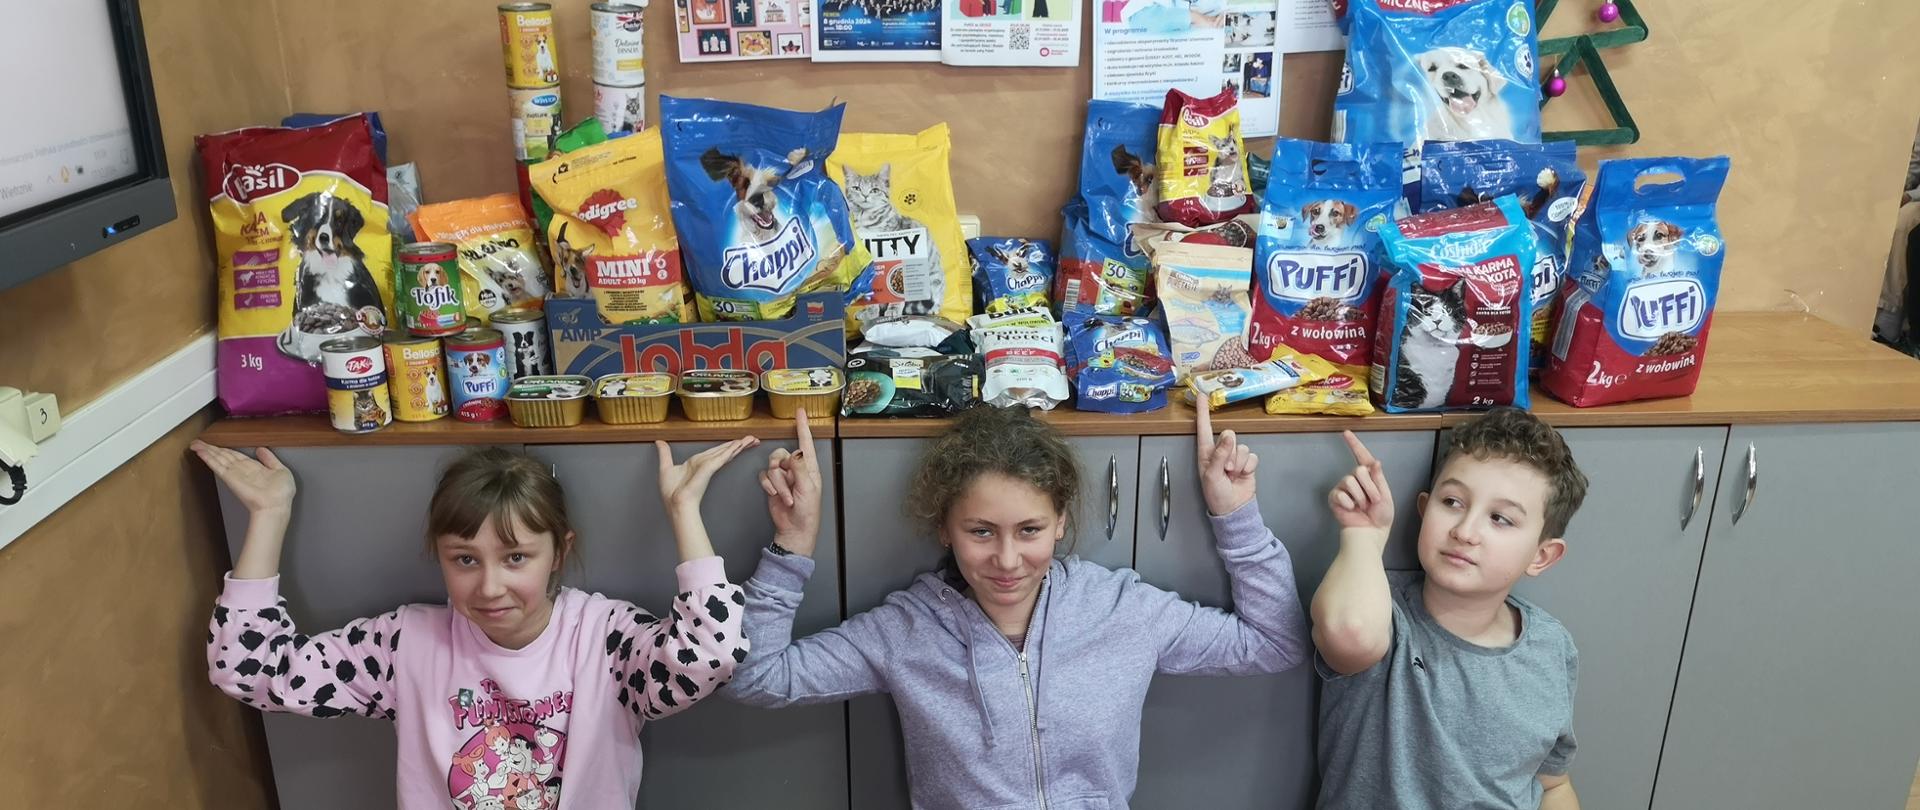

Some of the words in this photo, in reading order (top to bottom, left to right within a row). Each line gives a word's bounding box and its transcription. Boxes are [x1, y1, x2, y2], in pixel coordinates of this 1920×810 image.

[1112, 27, 1147, 35] programie
[571, 198, 637, 222] edigree
[722, 226, 805, 289] Chappi
[596, 258, 651, 277] MINI
[1107, 262, 1126, 278] 30
[1473, 257, 1515, 276] KARMA
[1487, 267, 1517, 283] KOTA
[411, 286, 459, 309] Tofik
[714, 301, 734, 313] 30
[996, 334, 1056, 344] Noteci
[1291, 325, 1298, 335] z
[1302, 326, 1366, 340] wołowiną
[241, 355, 247, 367] 3
[249, 354, 263, 370] kg
[1636, 363, 1645, 373] z
[1472, 396, 1481, 405] 2
[1482, 397, 1494, 407] kg
[40, 408, 48, 424] 3
